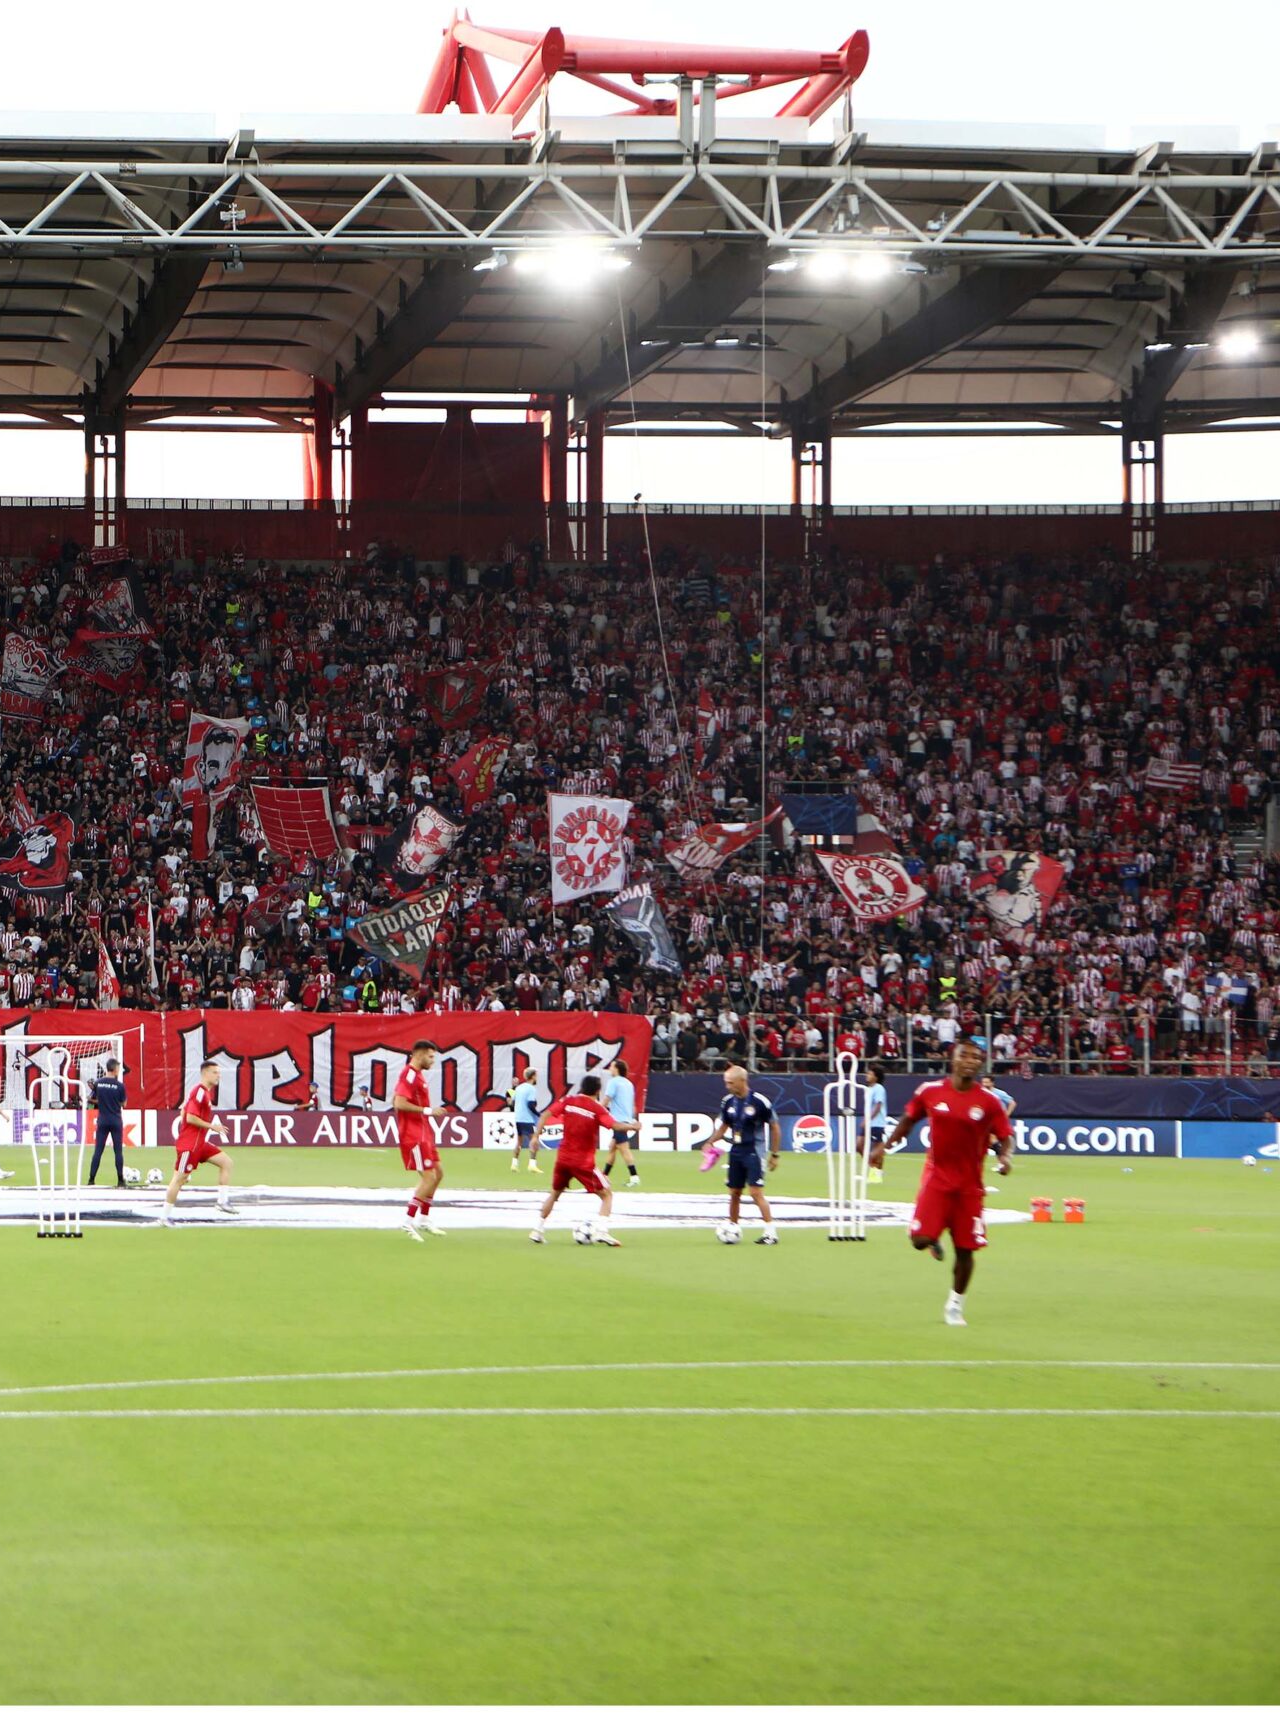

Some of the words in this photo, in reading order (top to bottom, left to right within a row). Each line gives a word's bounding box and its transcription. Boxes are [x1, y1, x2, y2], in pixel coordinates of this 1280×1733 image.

[176, 1020, 625, 1112] belongs
[312, 1113, 469, 1145] AIRWYS
[796, 1130, 830, 1139] PEPS
